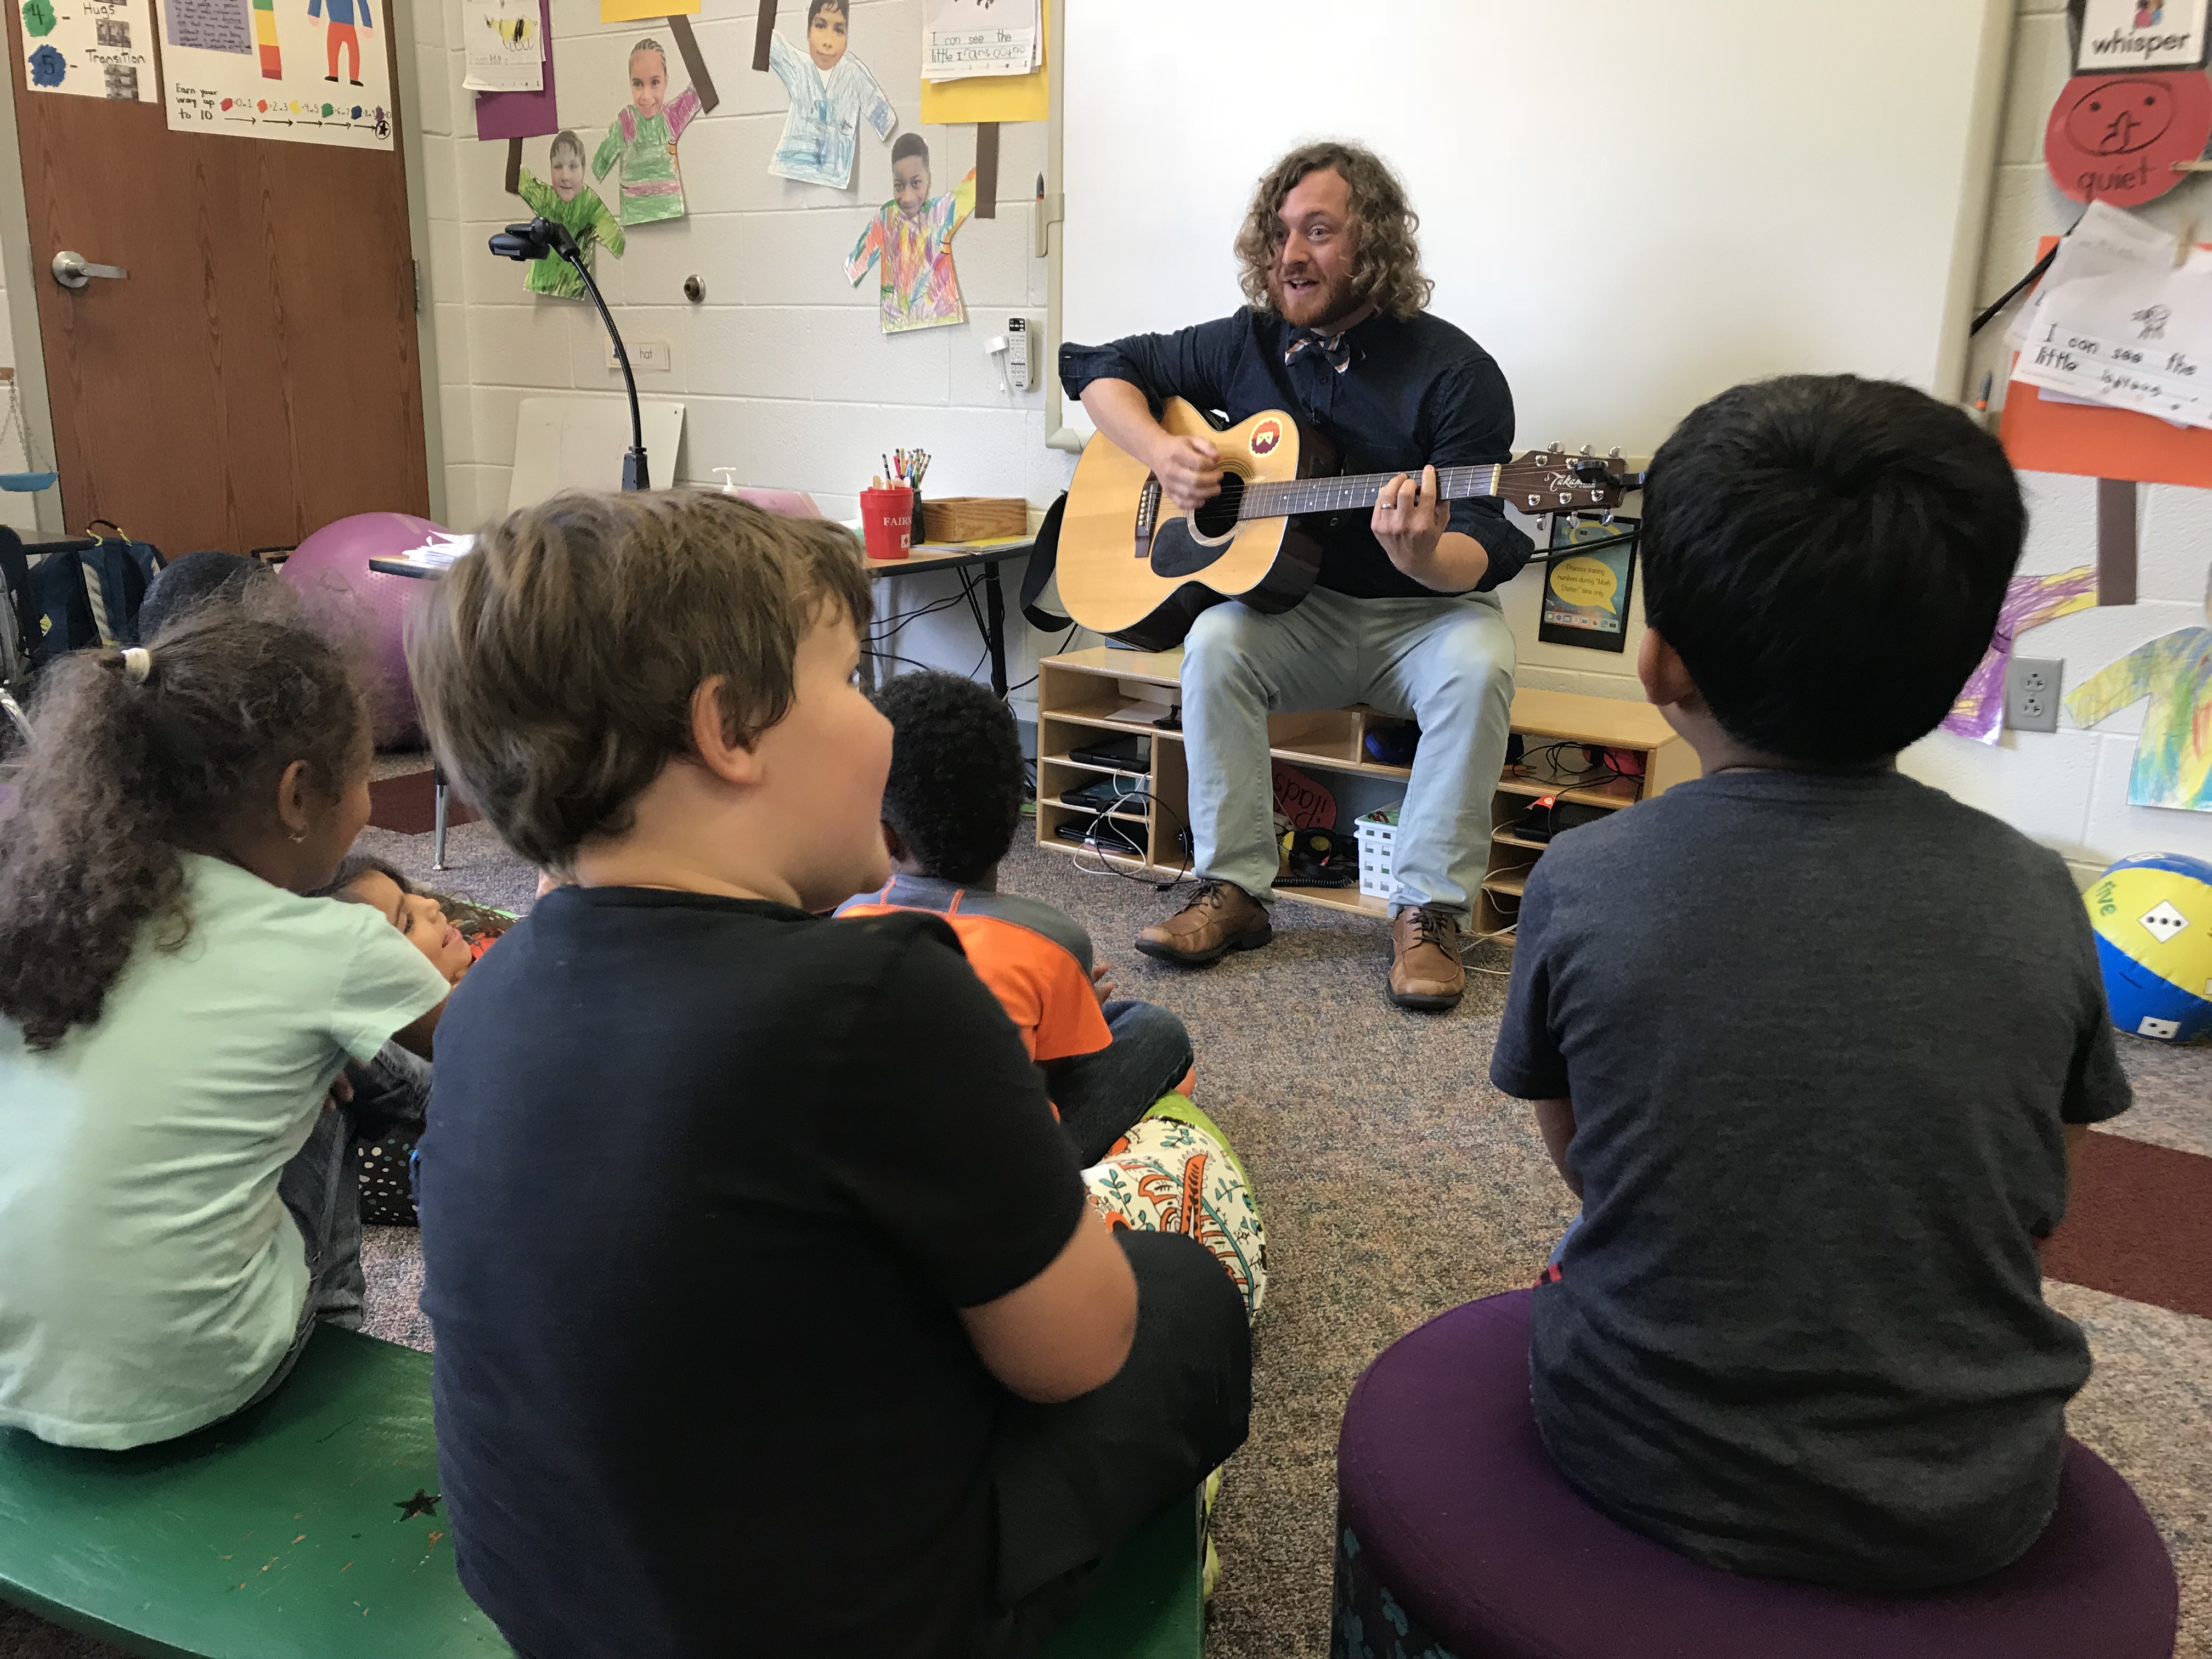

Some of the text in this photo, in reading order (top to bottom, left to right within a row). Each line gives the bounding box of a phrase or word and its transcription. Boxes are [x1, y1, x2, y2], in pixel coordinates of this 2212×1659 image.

[31, 3, 45, 25] 4
[83, 3, 115, 19] Hugs
[932, 29, 1012, 46] I can see the
[2091, 28, 2190, 60] whisper
[43, 55, 55, 75] 5
[85, 49, 145, 64] Transition
[932, 48, 953, 63] little
[176, 83, 218, 98] Earn your
[176, 97, 215, 109] way up
[178, 108, 213, 120] to 10
[2076, 155, 2156, 204] quiet
[639, 345, 652, 359] hat
[2044, 323, 2058, 342] I
[2068, 336, 2100, 354] can
[2111, 347, 2143, 363] see
[1544, 471, 1596, 492] Takam
[2096, 881, 2117, 916] five
